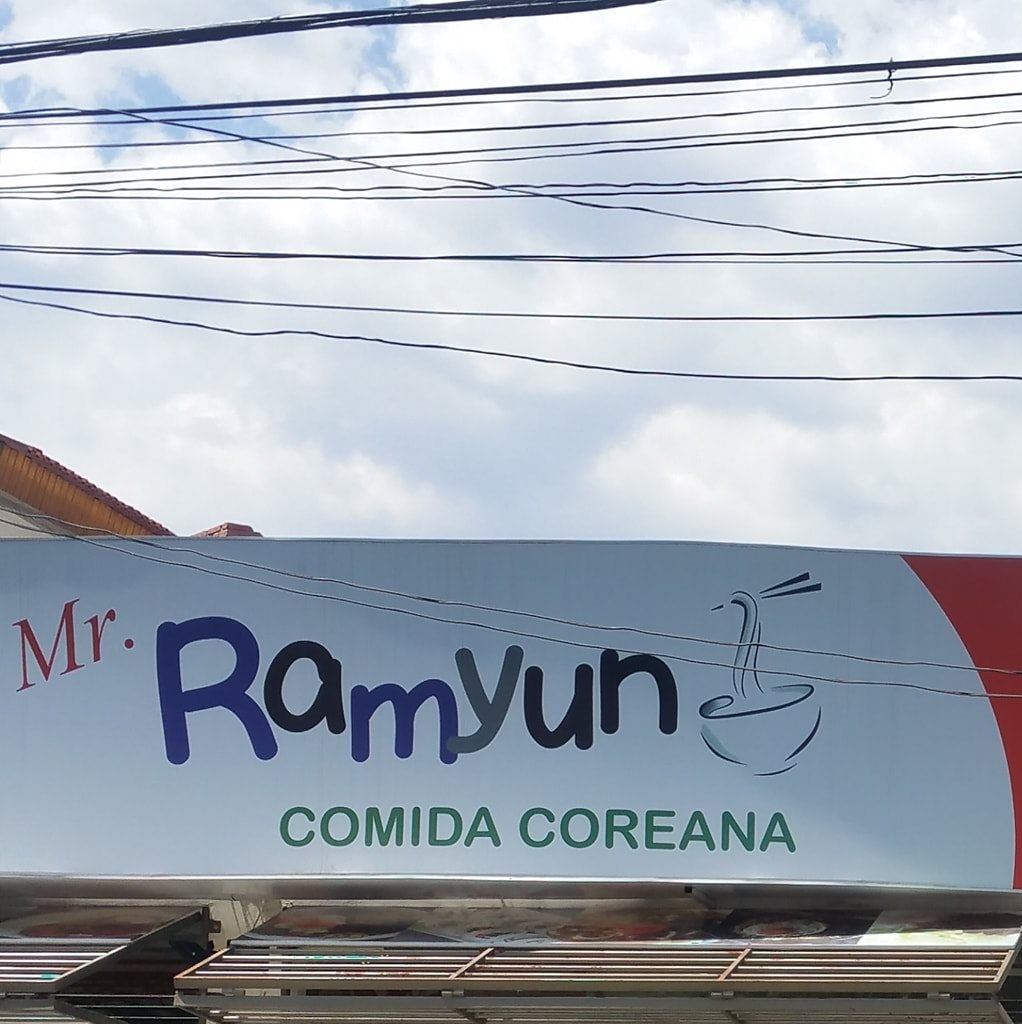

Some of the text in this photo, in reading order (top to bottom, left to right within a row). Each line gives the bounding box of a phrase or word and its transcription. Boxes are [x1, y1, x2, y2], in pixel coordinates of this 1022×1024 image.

[12, 598, 678, 765] Mr. Ramyun
[279, 806, 797, 853] COMIDA COREANA
